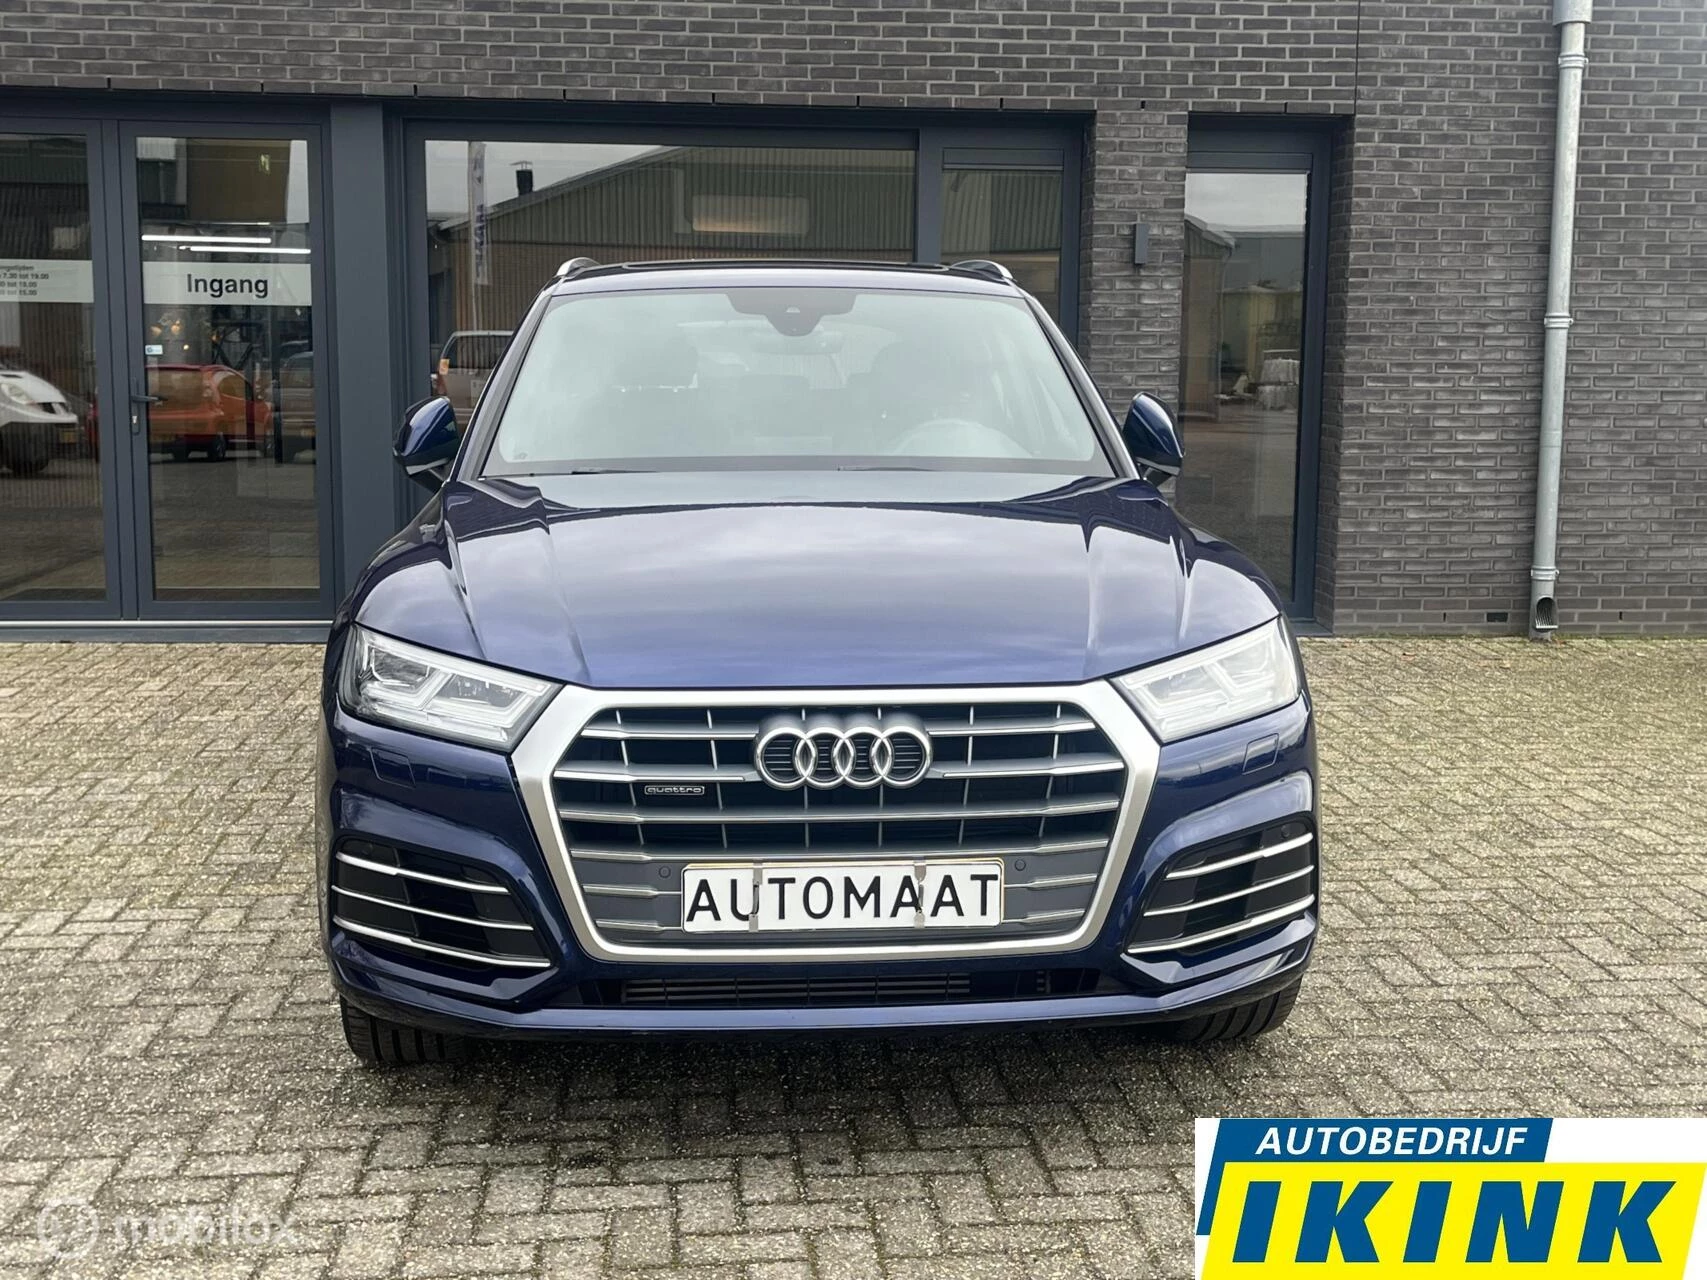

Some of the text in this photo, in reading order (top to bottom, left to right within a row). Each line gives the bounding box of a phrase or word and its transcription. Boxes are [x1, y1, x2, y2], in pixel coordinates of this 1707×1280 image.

[187, 274, 269, 298] Ingang
[647, 785, 702, 795] quattro
[685, 874, 999, 922] AUTOMAAT
